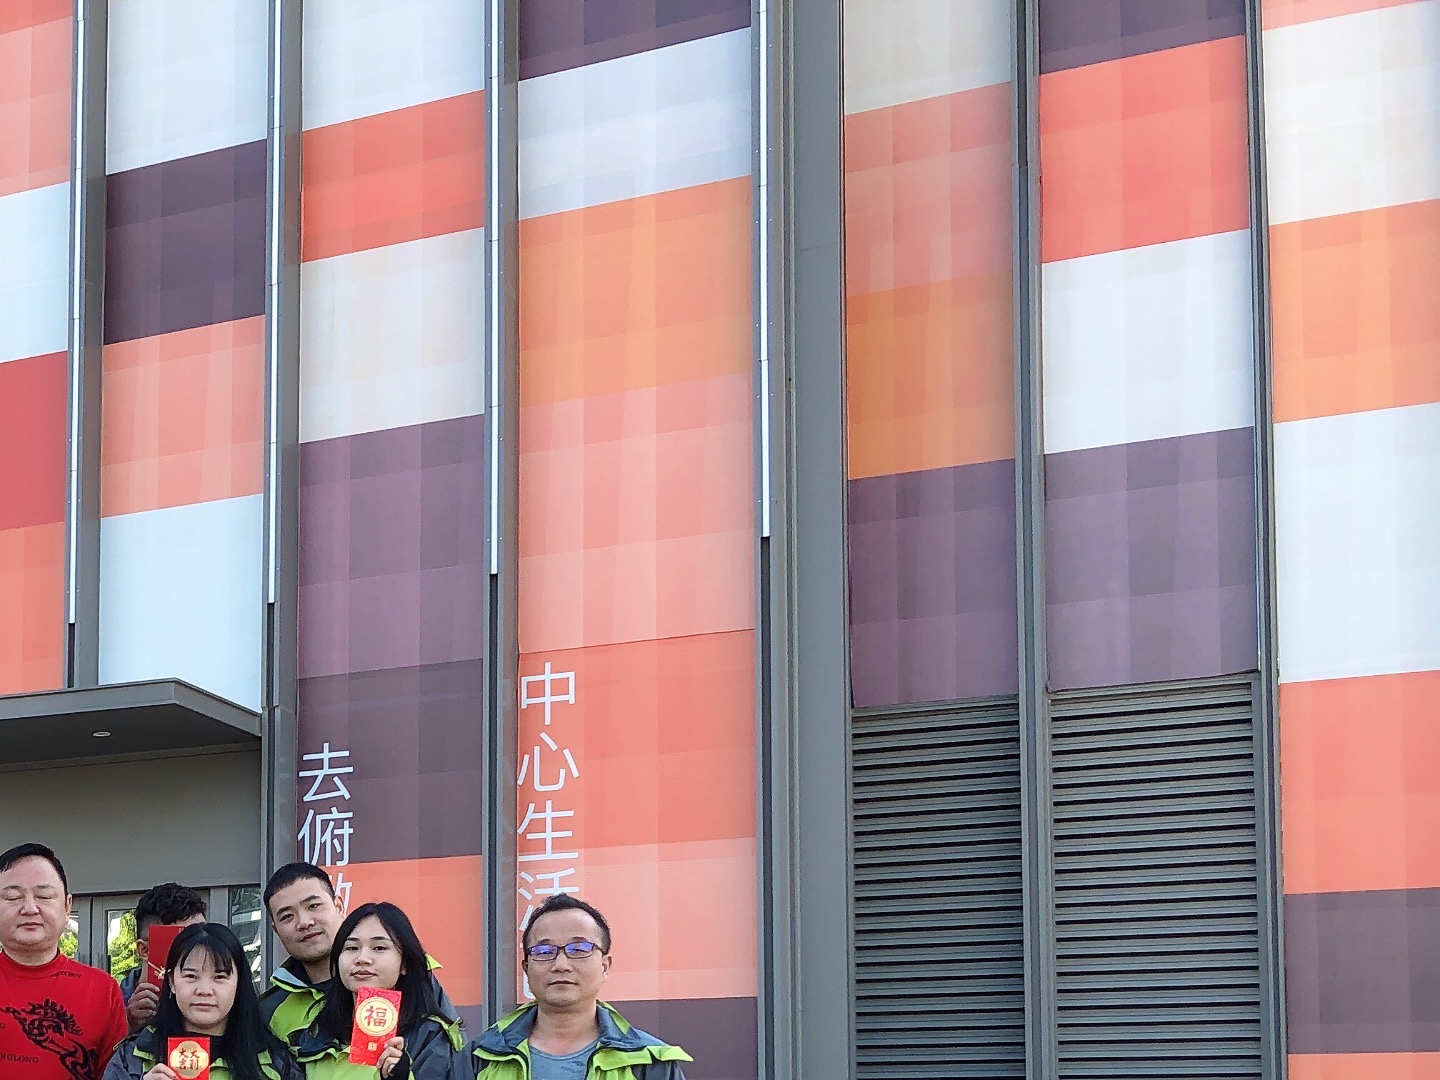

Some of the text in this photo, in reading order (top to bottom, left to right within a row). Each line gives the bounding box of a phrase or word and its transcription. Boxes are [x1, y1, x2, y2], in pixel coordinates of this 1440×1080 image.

[517, 661, 580, 998] 中心生活
[364, 1005, 388, 1028] 福
